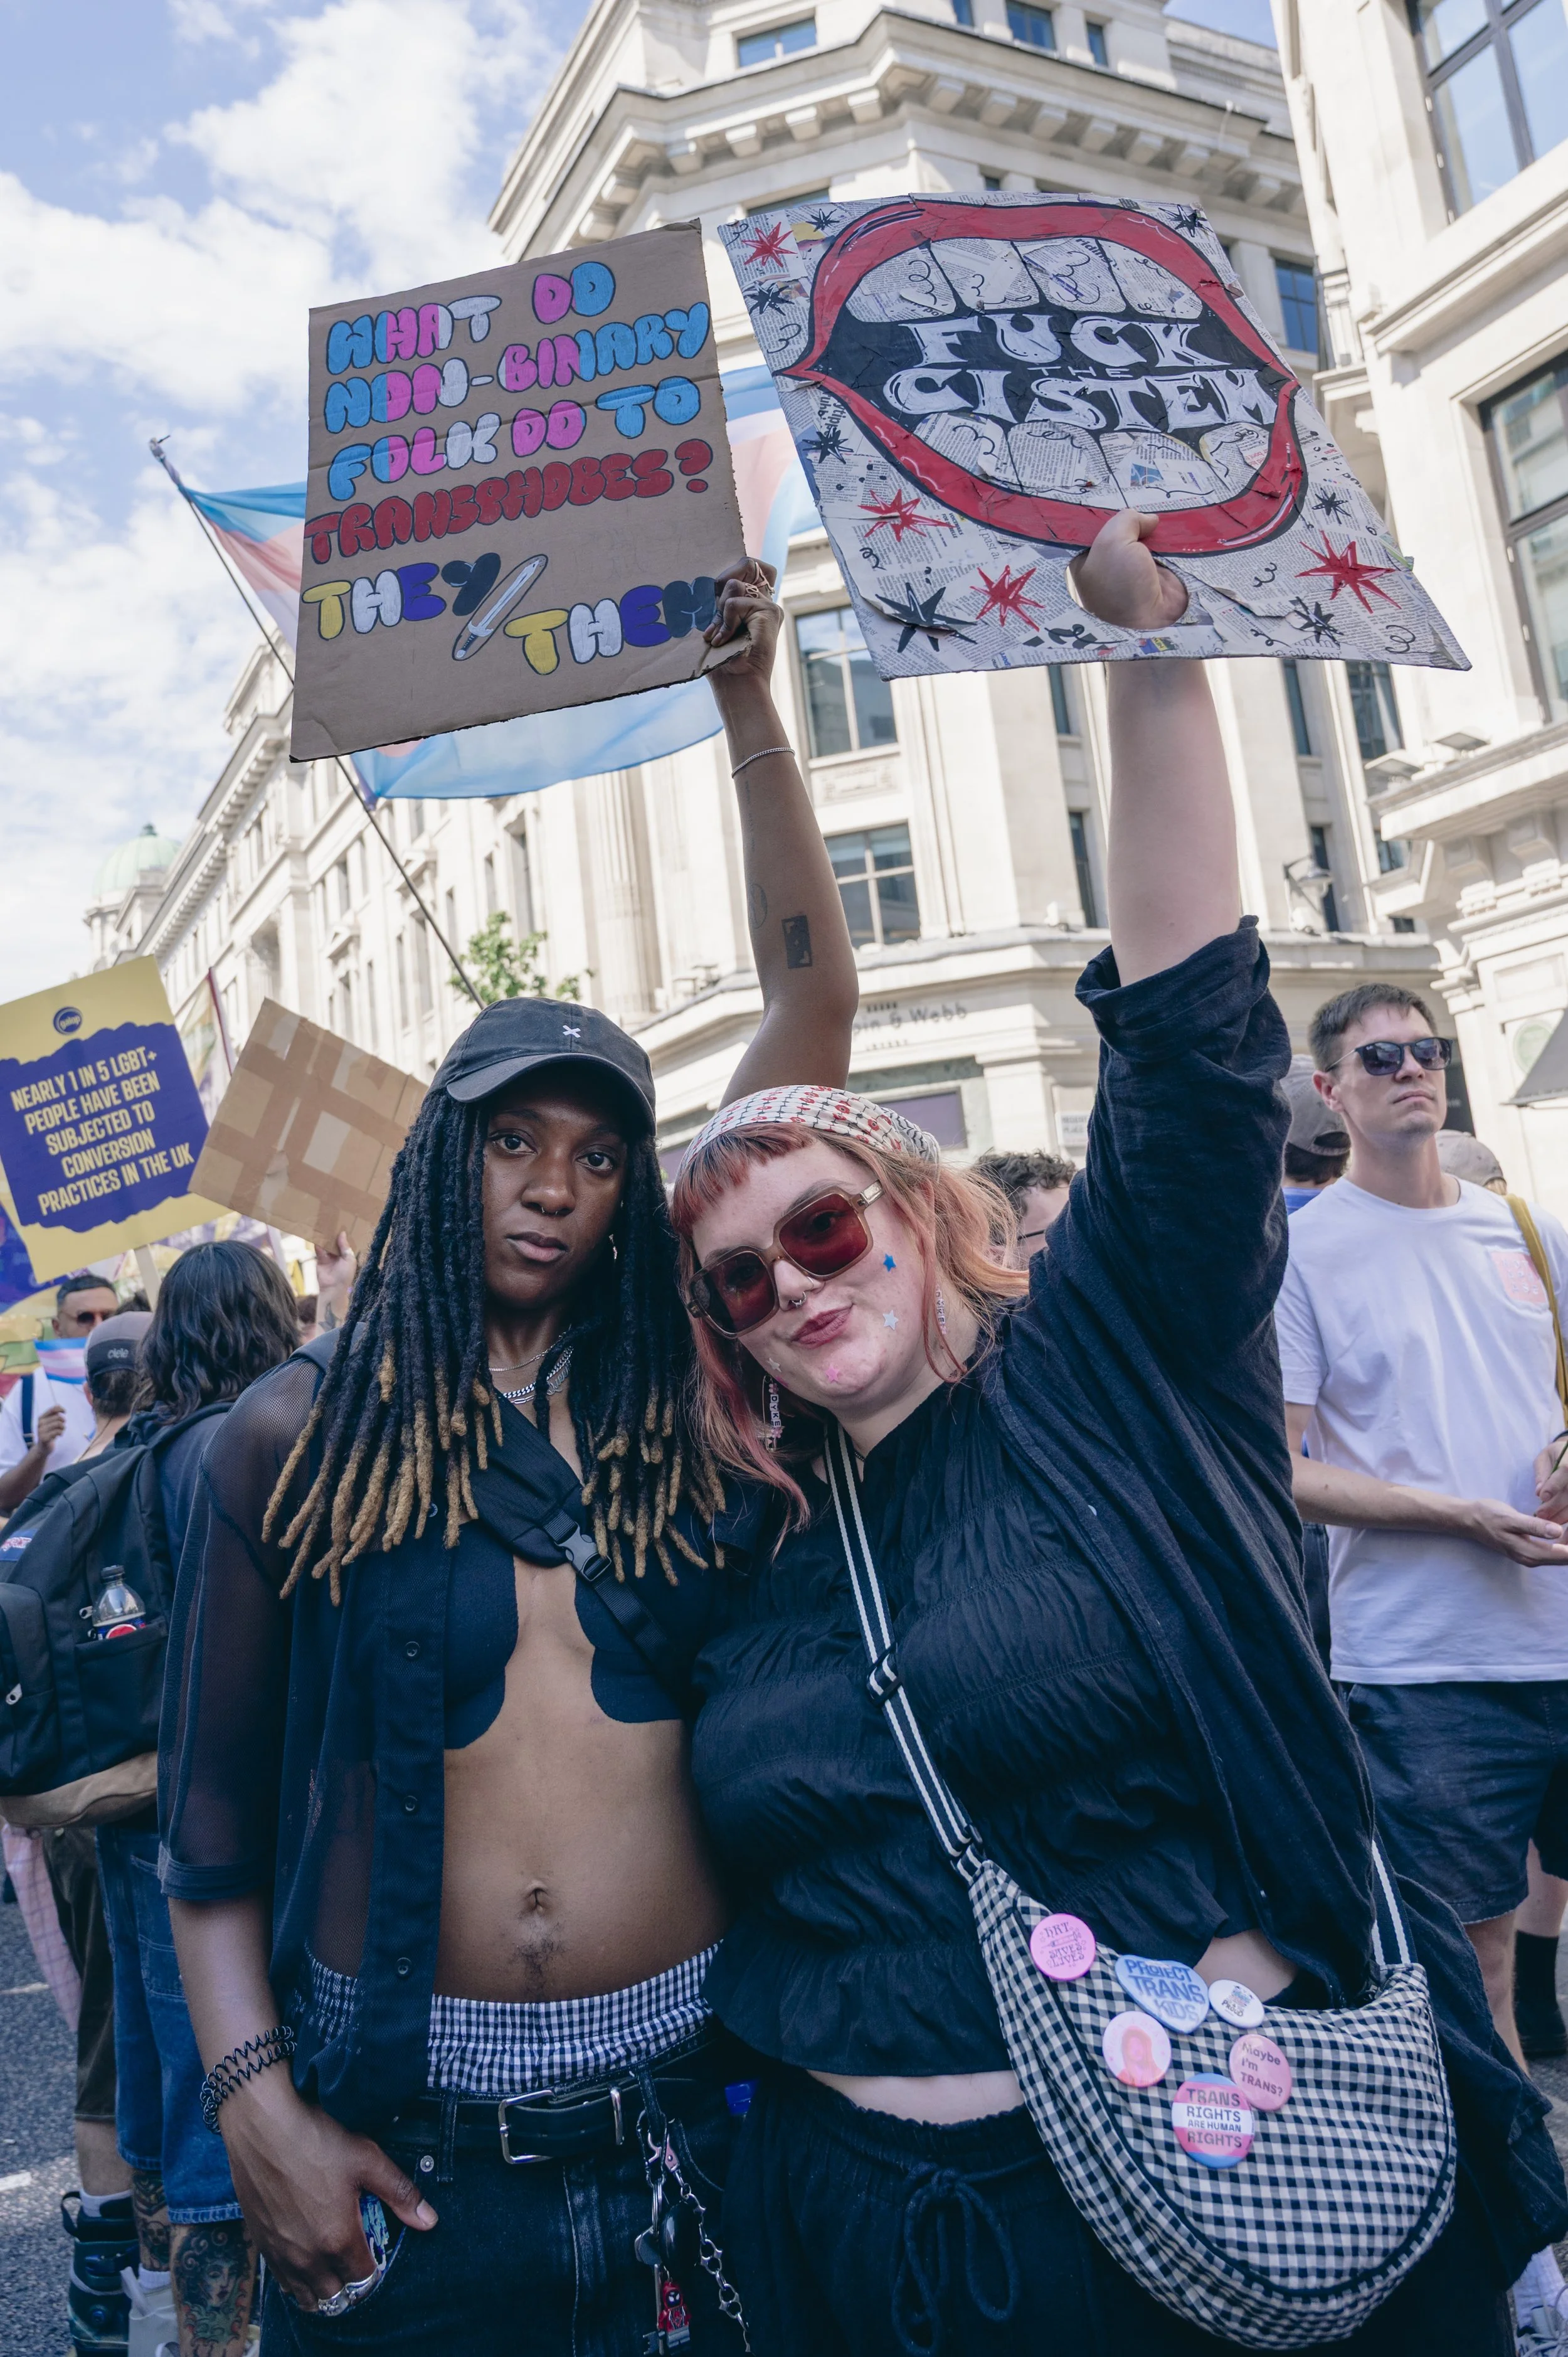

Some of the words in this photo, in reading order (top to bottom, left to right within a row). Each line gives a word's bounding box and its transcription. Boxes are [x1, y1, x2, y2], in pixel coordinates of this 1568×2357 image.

[326, 295, 502, 375] WHAT
[532, 261, 615, 324] DO
[898, 314, 1232, 368] FUCK
[324, 302, 710, 434] NON-BINARY
[1026, 365, 1133, 378] THE
[883, 368, 1278, 434] CISTEM
[328, 413, 502, 501] FOLK
[512, 400, 586, 457] DO
[596, 377, 701, 439] TO
[304, 439, 712, 565] TRANSPHOBES?
[302, 552, 502, 640] THEY
[504, 576, 719, 676] THEM
[909, 1001, 967, 1023] Webb
[11, 1074, 66, 1112] NEARLY
[67, 1070, 78, 1091] 1
[78, 1065, 97, 1089] IN
[96, 1060, 110, 1082] 5
[110, 1046, 157, 1077] LGBT+
[24, 1098, 81, 1136] PEOPLE
[80, 1084, 122, 1115] HAVE
[121, 1070, 161, 1102] BEEN
[45, 1108, 132, 1156] SUBJECTED
[132, 1100, 156, 1125] TO
[61, 1128, 156, 1179] CONVERSION
[38, 1168, 121, 1216] PRACTICES
[120, 1161, 140, 1186] IN
[139, 1151, 172, 1179] THE
[170, 1142, 195, 1169] UK
[771, 1395, 780, 1427] DYKE
[1049, 1942, 1082, 1959] SAVES
[1051, 1950, 1084, 1967] LIVES
[1128, 1975, 1205, 2004] TRANS
[1154, 1999, 1200, 2022] KIDS
[1242, 2042, 1281, 2065] Maybe
[1186, 2088, 1241, 2107] TRANS
[1241, 2071, 1283, 2097] TRANS?
[1187, 2105, 1241, 2122] RIGHTS
[1188, 2119, 1205, 2128] ARE
[1207, 2122, 1241, 2132] HUMAN
[1187, 2131, 1242, 2148] RIGHTS
